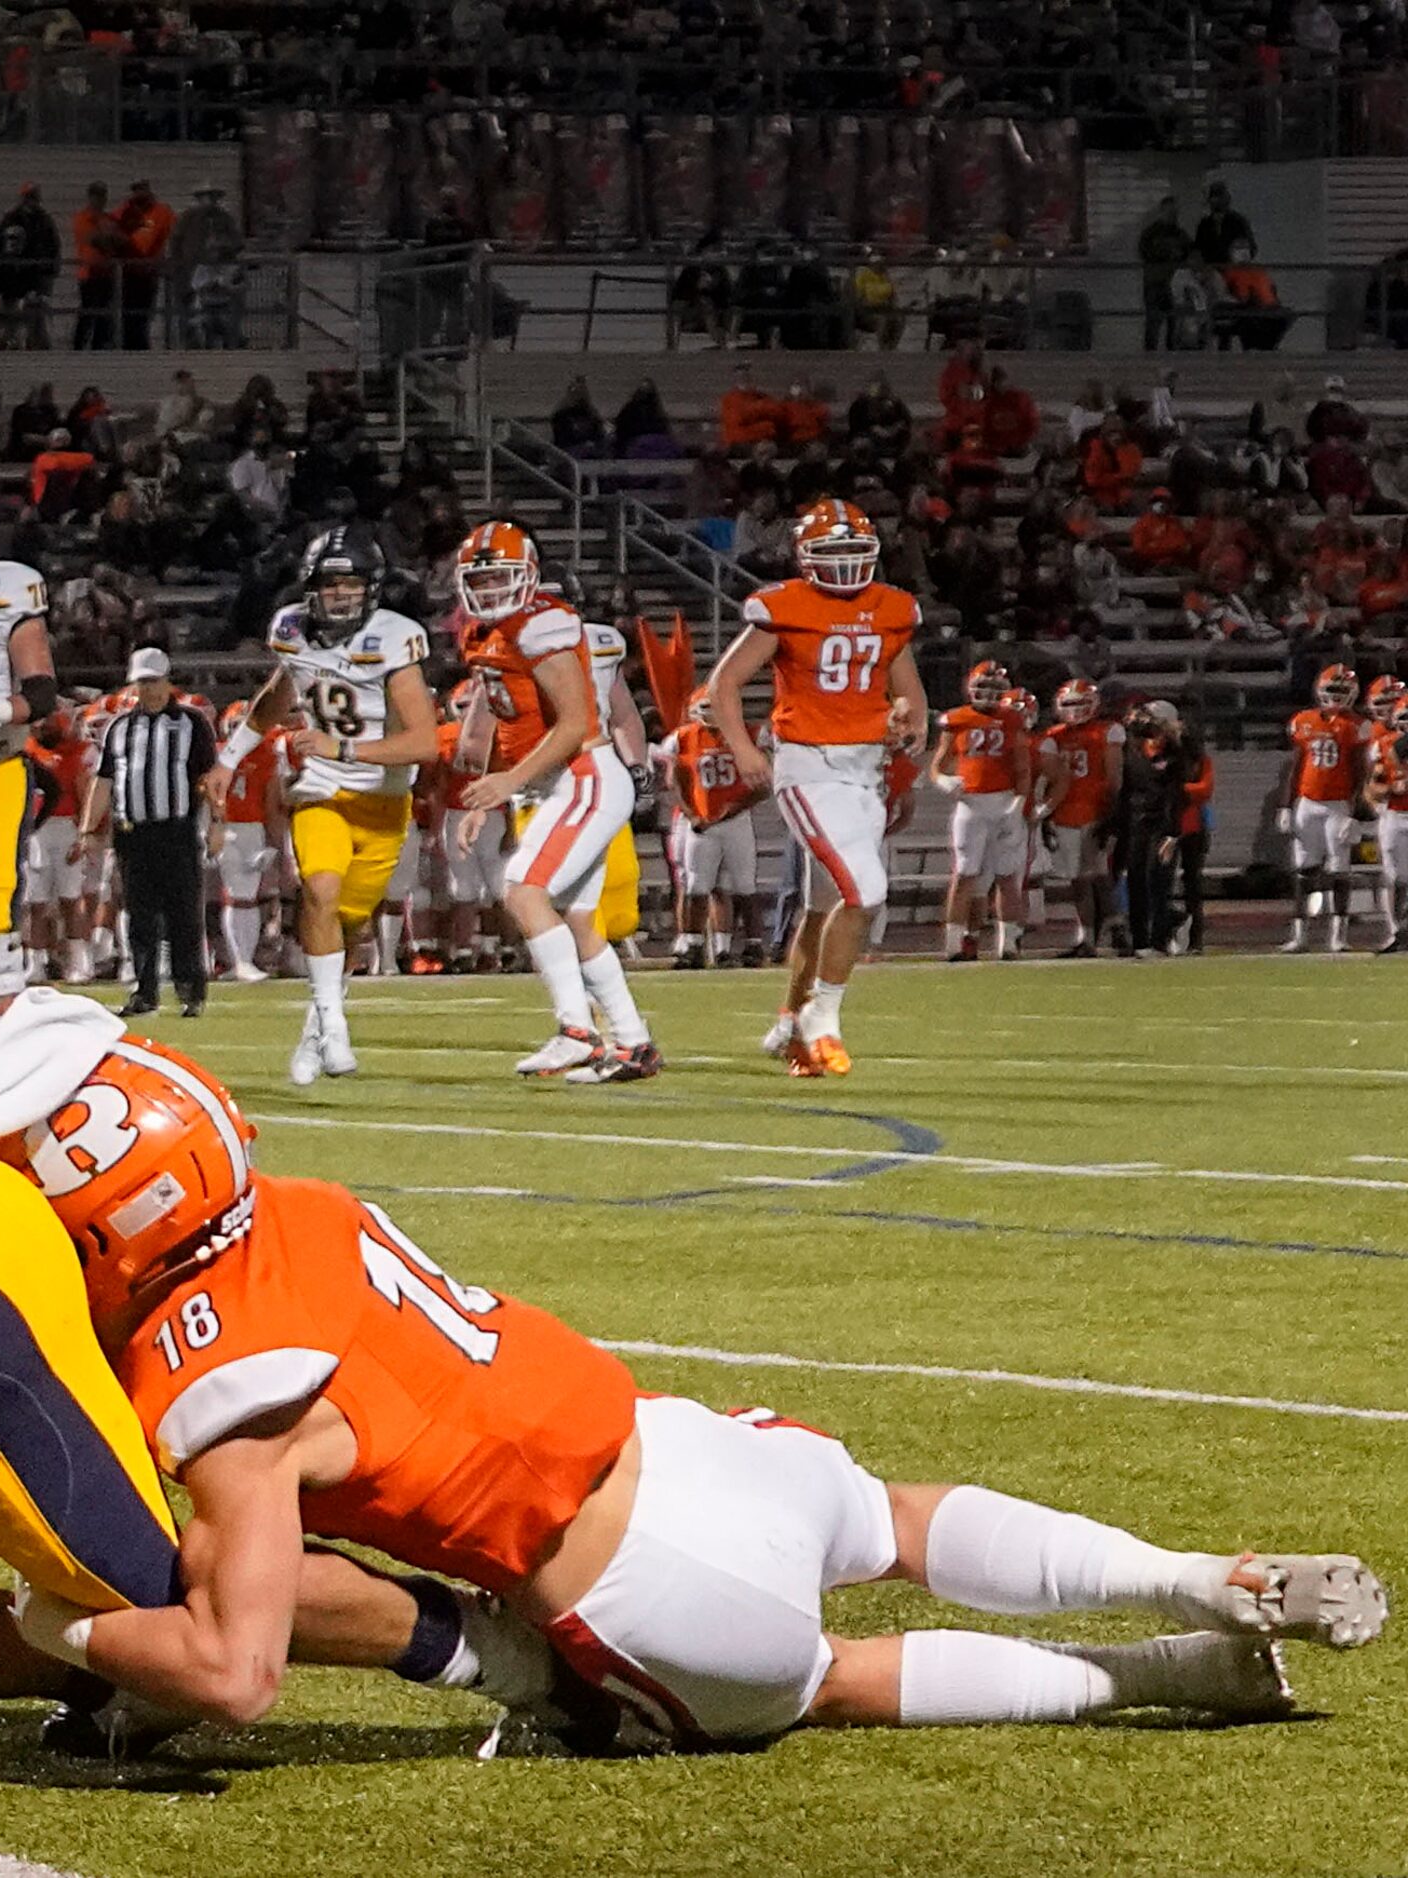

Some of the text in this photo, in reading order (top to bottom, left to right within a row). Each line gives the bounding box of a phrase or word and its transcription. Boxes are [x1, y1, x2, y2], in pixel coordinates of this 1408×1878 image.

[818, 634, 883, 694] 97
[306, 678, 366, 737] 13
[967, 728, 1005, 757] 22
[23, 1081, 140, 1198] R
[153, 1290, 222, 1374] 18
